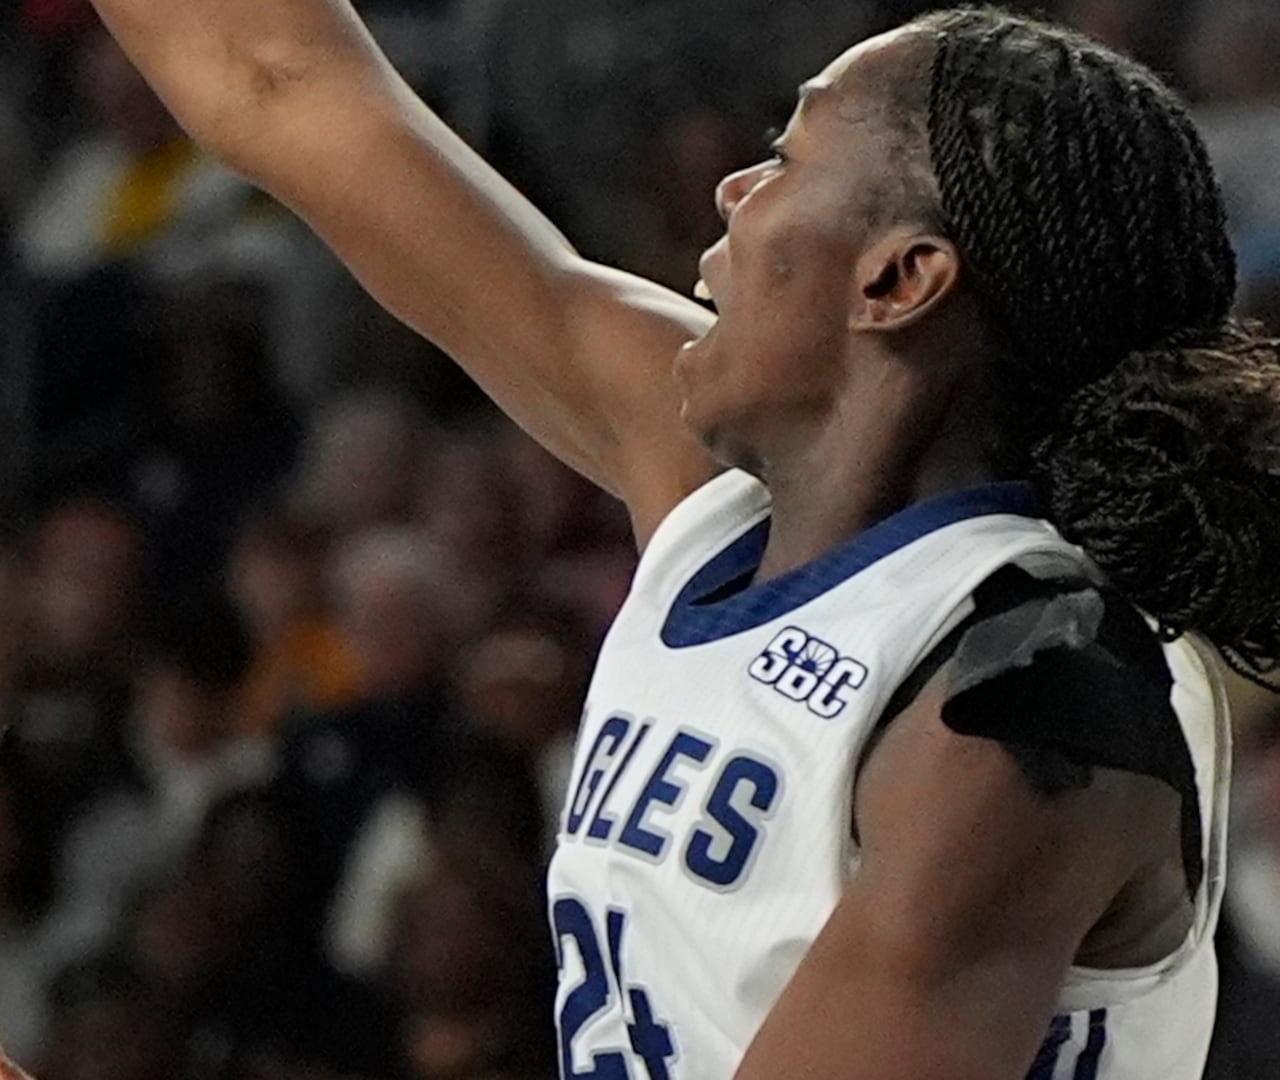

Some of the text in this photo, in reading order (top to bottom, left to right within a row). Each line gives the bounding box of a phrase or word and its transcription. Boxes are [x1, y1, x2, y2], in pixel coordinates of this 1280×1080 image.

[747, 624, 869, 720] SBC
[562, 712, 783, 890] GLES
[552, 896, 676, 1080] 24
